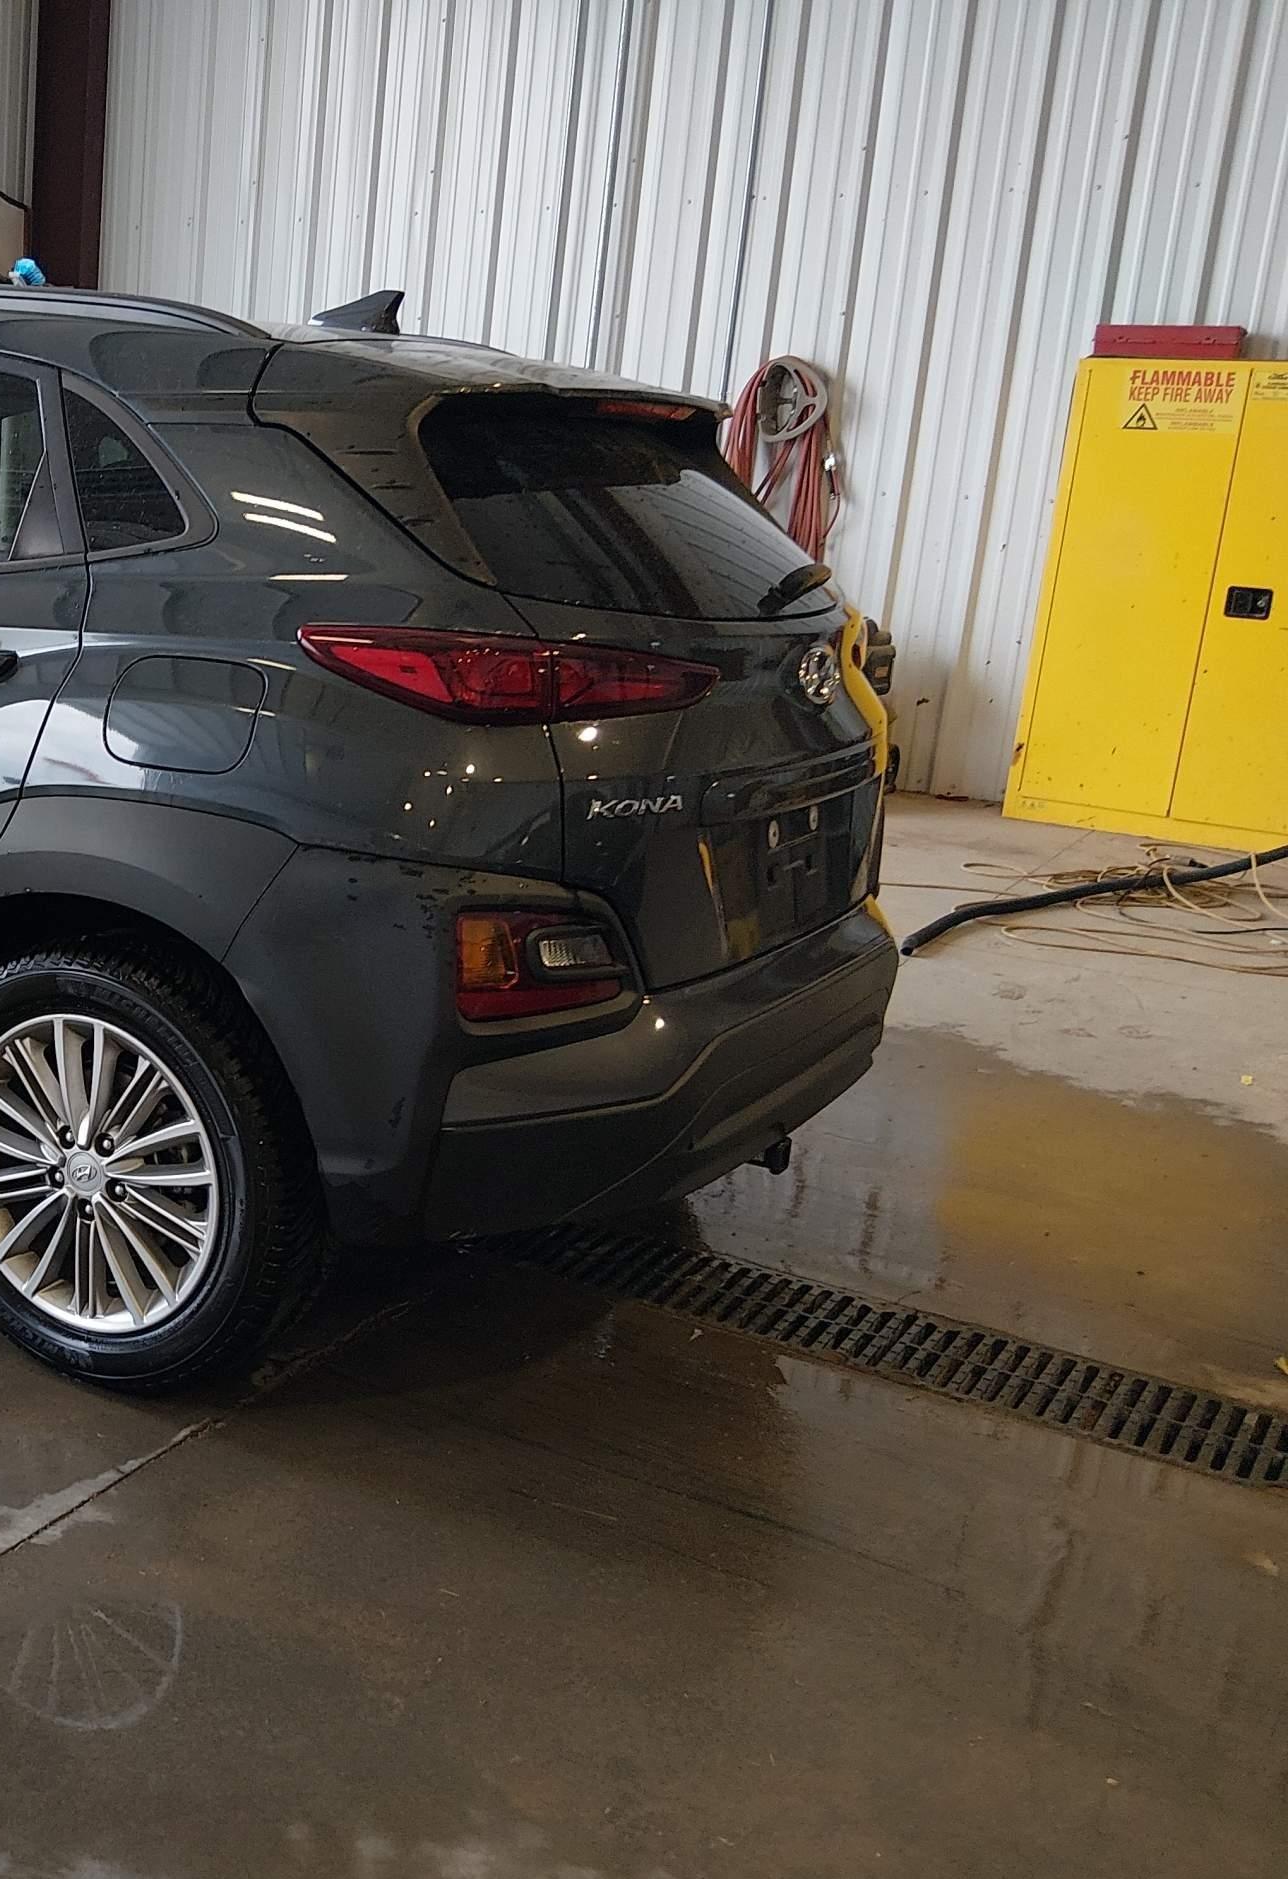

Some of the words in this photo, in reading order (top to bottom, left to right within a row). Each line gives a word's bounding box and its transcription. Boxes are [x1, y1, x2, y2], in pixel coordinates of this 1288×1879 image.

[1130, 369, 1236, 387] FLAMMABLE
[1128, 386, 1160, 402] KEEP
[1162, 387, 1192, 402] FIRE
[1193, 388, 1234, 404] AWAY
[586, 795, 683, 820] KONA
